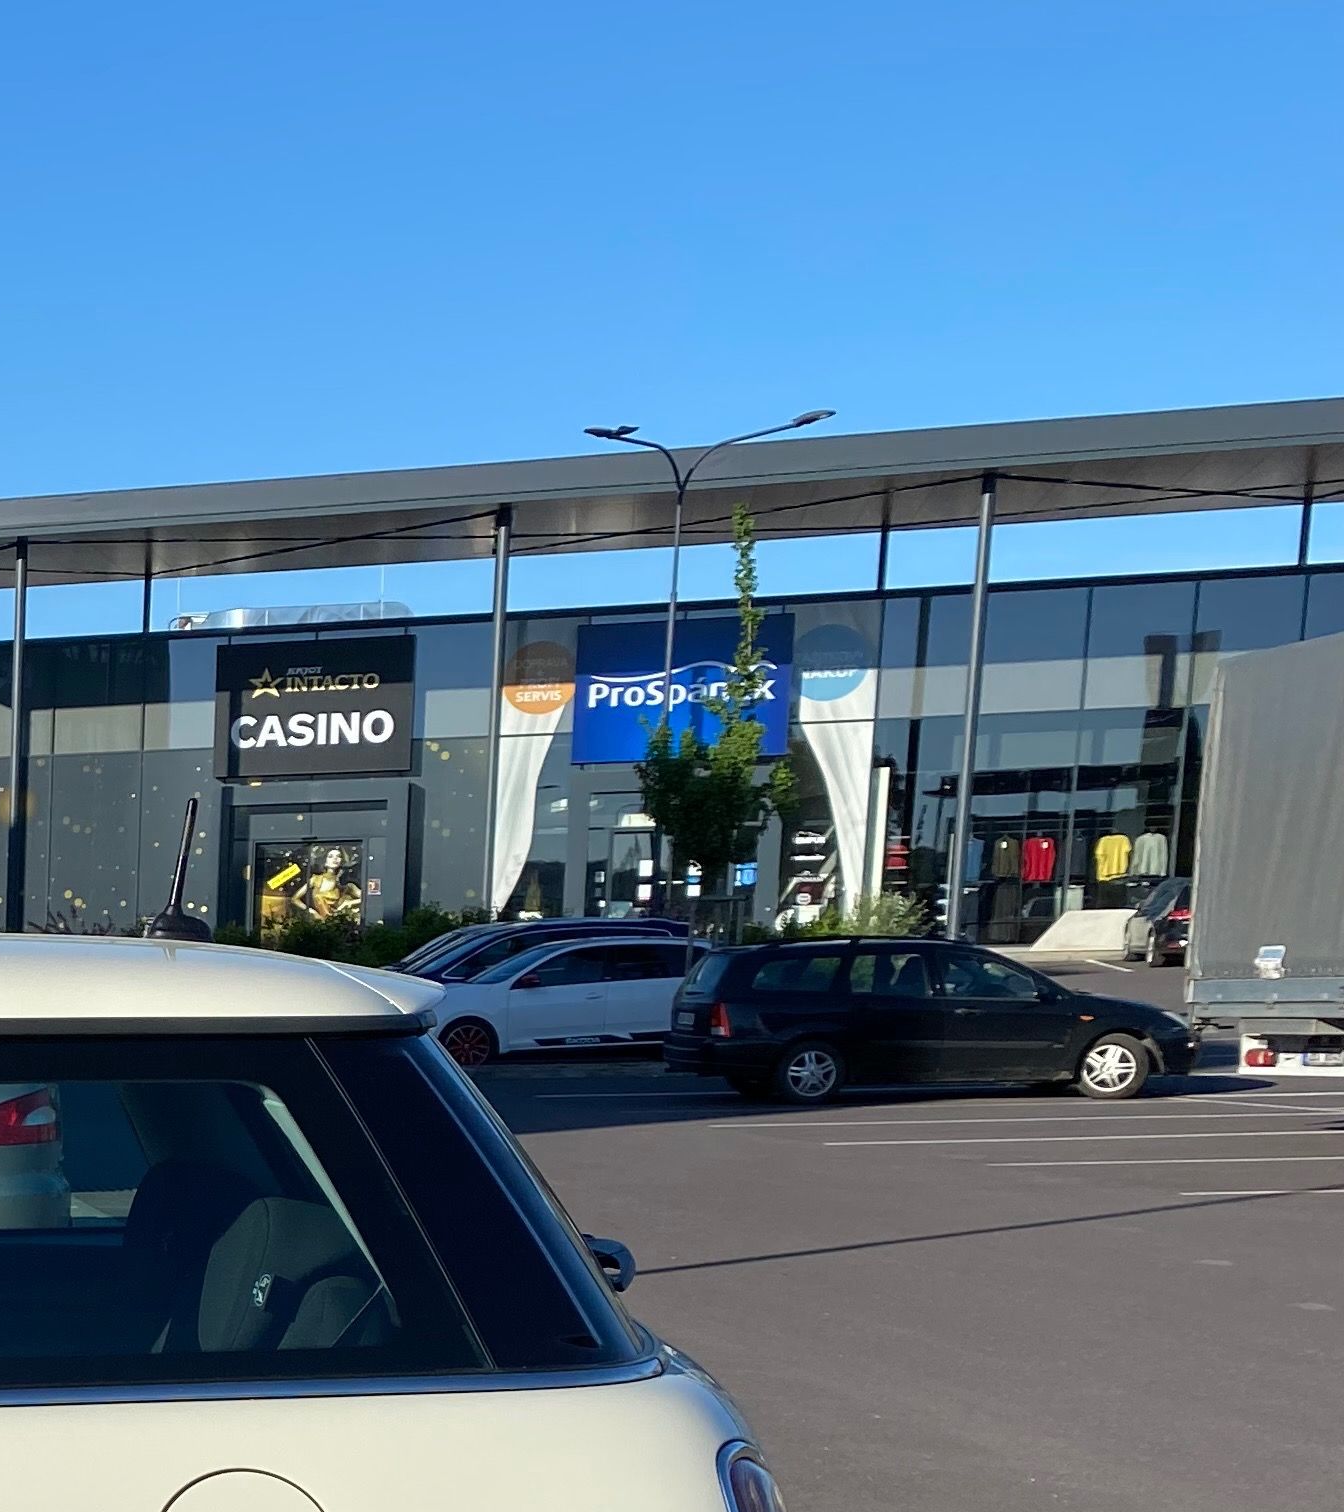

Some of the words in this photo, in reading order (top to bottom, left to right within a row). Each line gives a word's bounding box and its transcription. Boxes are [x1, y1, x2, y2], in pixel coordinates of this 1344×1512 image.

[284, 673, 380, 692] INTACTO
[515, 690, 562, 703] SERVIS
[231, 710, 394, 749] CASINO
